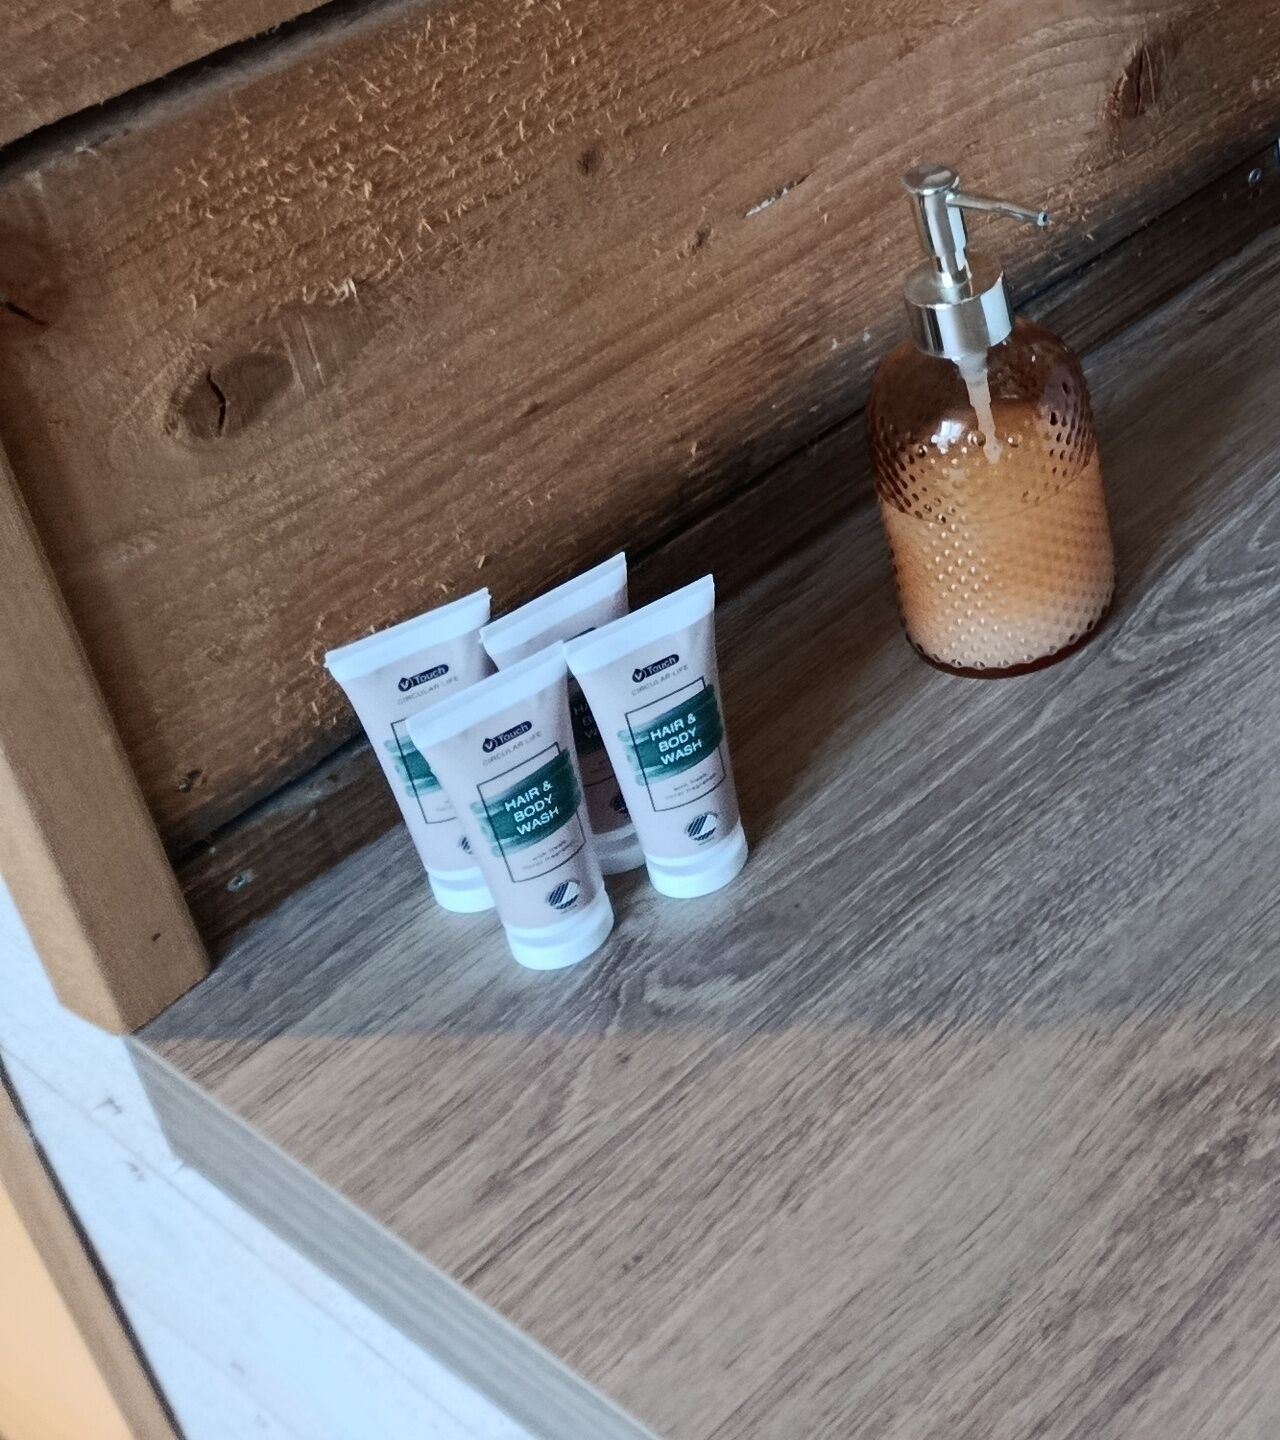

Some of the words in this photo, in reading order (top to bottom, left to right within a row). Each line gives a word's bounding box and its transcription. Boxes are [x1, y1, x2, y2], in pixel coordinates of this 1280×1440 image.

[650, 718, 685, 741] HAIR
[687, 713, 697, 725] &
[658, 727, 697, 753] BODY
[660, 738, 703, 765] WASH
[504, 787, 540, 812] HAIR
[542, 780, 553, 792] &
[513, 793, 553, 823] BODY
[516, 806, 560, 835] WASH
